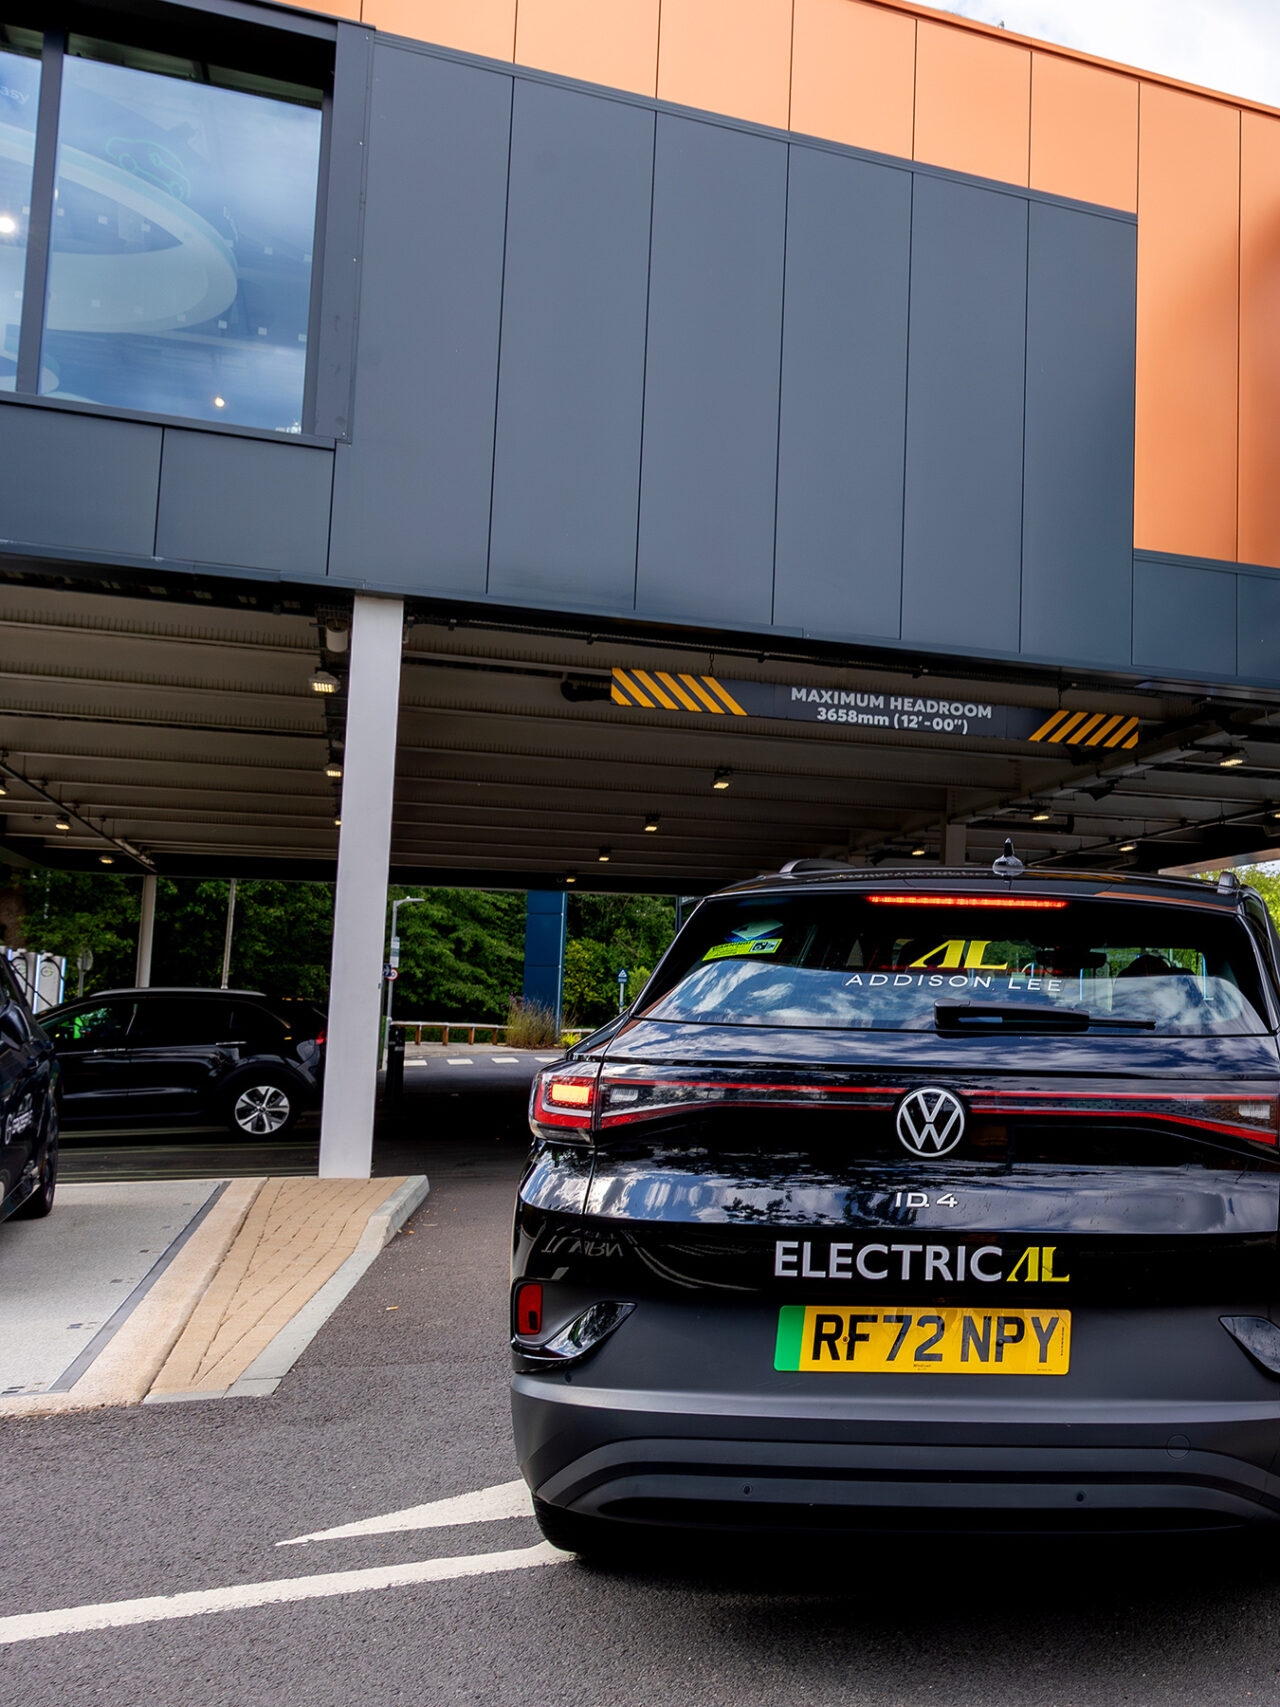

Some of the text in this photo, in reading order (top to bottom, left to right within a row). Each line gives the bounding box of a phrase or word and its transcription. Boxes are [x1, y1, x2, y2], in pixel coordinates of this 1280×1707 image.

[791, 686, 992, 719] MAXIMUM HEADROOM
[816, 707, 890, 727] 3658mm
[908, 939, 1009, 970] AL
[845, 974, 1063, 992] ADDISON LEE
[811, 1313, 945, 1363] RF72
[960, 1315, 1060, 1364] NPY
